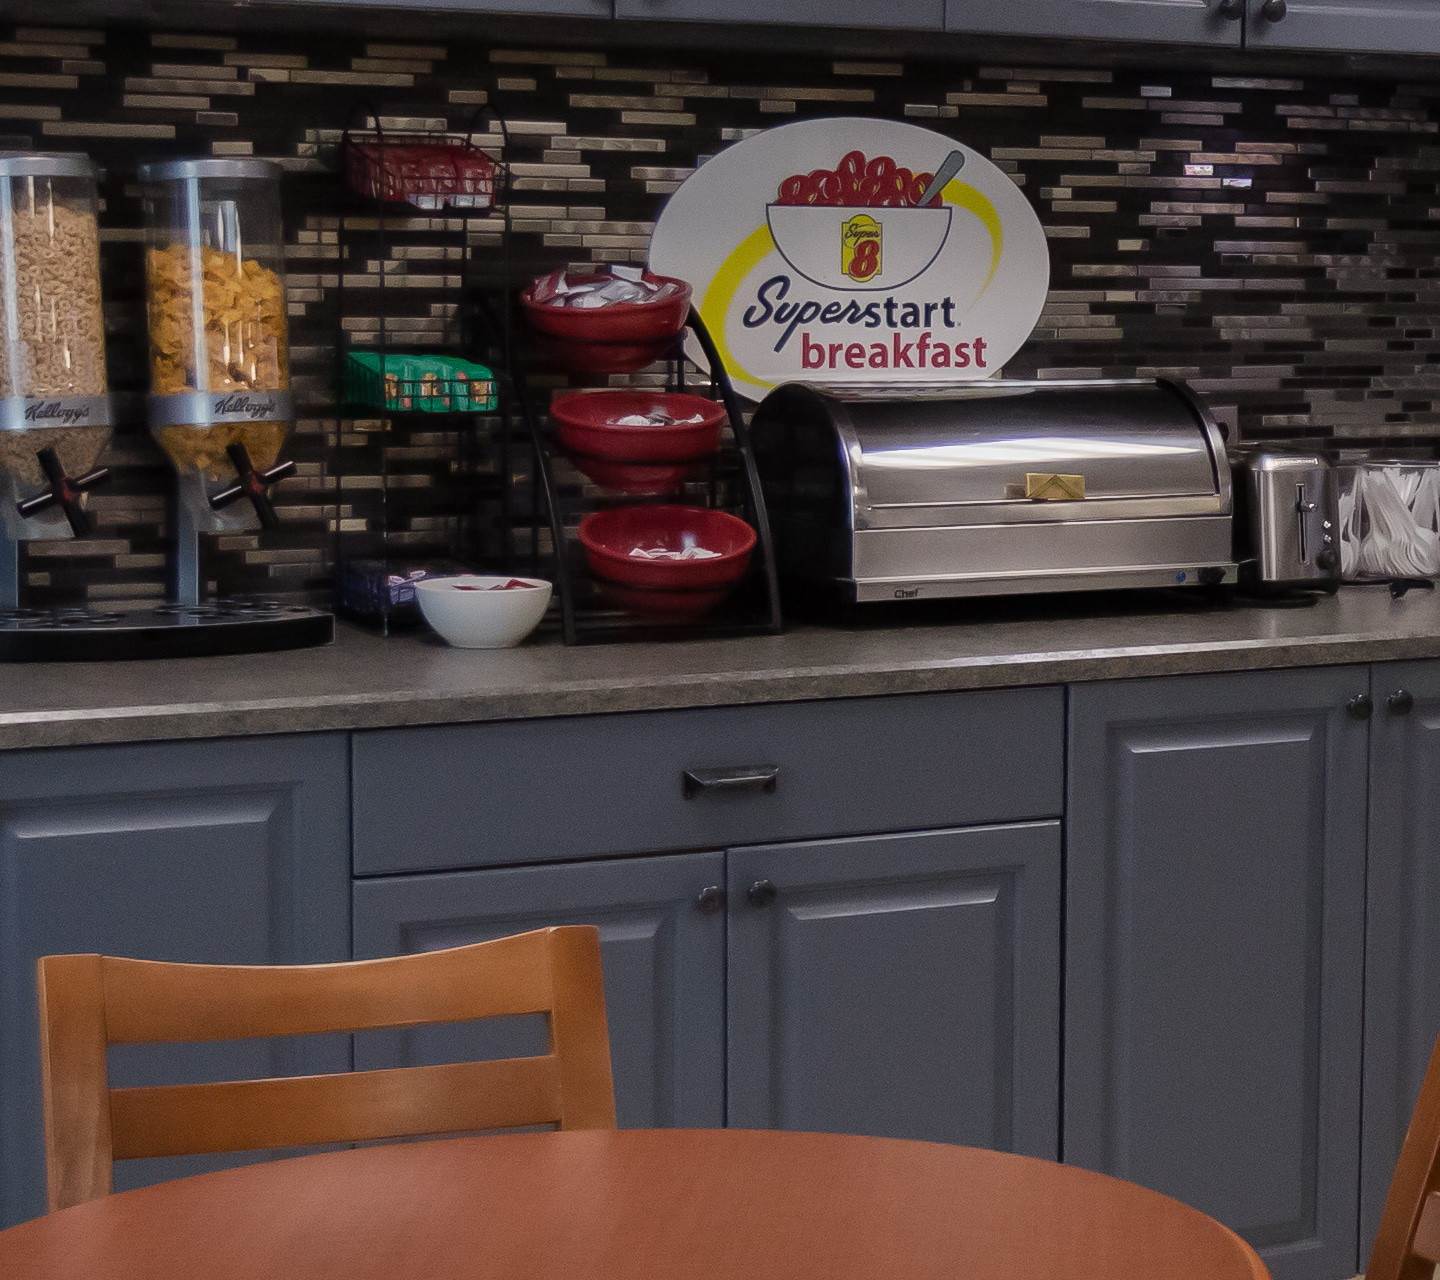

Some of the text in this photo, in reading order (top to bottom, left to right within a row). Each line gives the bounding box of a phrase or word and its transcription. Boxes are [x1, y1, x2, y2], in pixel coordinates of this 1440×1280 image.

[844, 223, 881, 246] Super
[848, 239, 881, 278] 8
[743, 275, 956, 353] Superstart
[801, 331, 988, 369] breakfast
[25, 400, 90, 424] Kellogg's
[214, 395, 277, 419] Kellogg's
